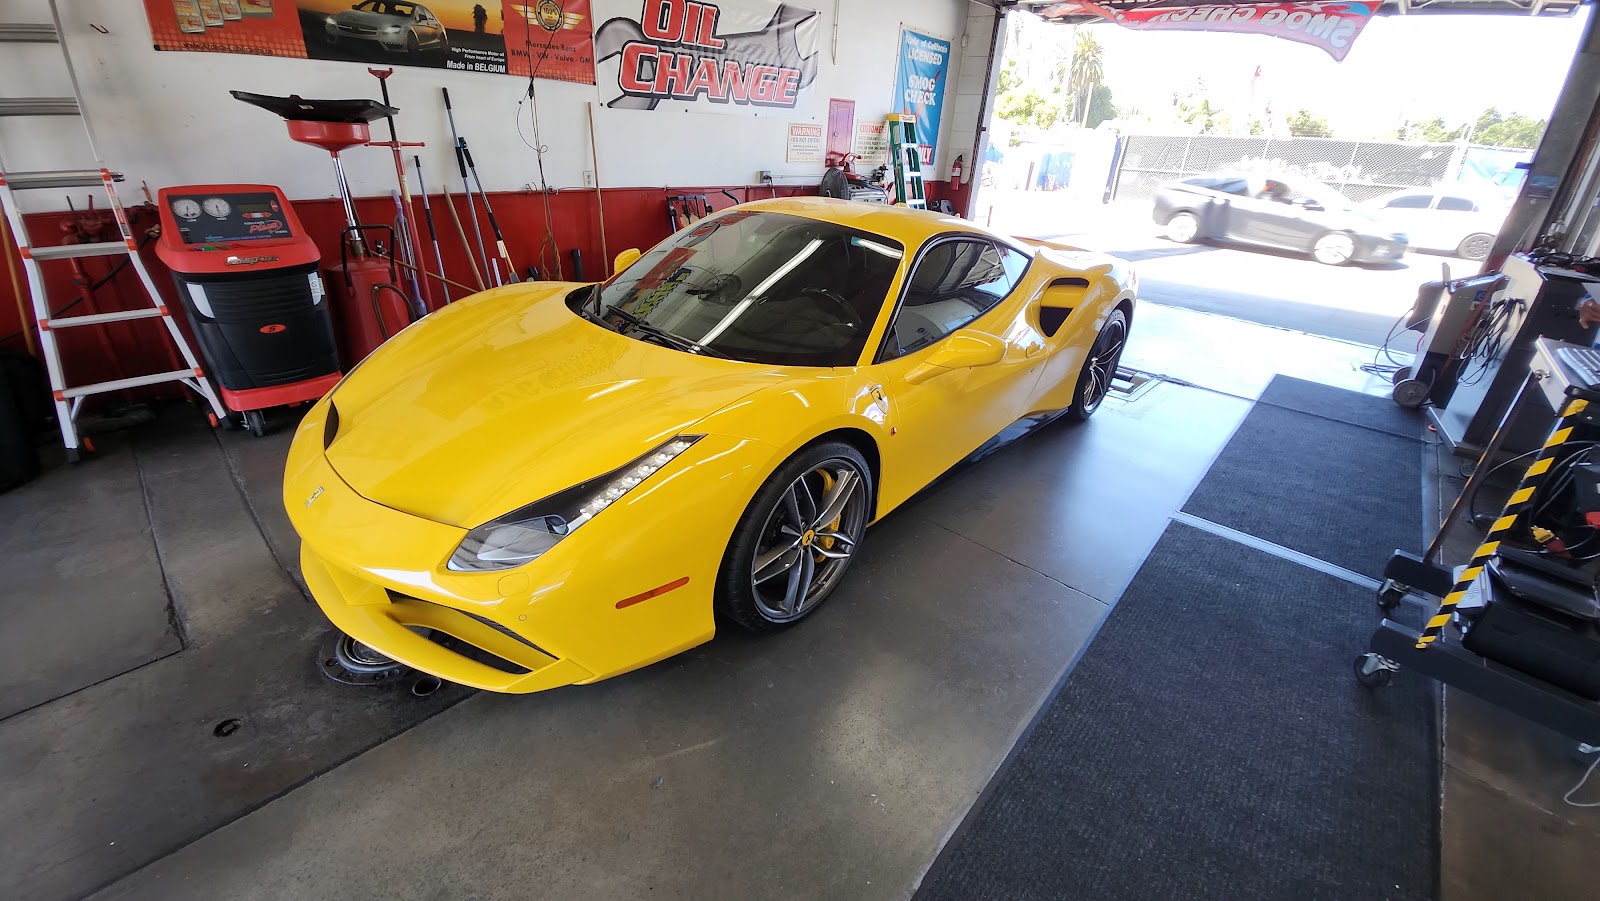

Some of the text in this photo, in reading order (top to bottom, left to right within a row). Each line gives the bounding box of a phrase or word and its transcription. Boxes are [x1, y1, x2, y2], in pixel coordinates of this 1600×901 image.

[641, 0, 727, 49] OIL
[462, 47, 487, 56] Performance
[904, 34, 948, 54] State of California
[554, 54, 574, 63] Volvo
[908, 48, 942, 65] LICENSED
[447, 60, 506, 74] Made in BELGIUM
[619, 42, 800, 104] CHANGE
[908, 74, 936, 91] SMOG
[904, 88, 937, 106] CHECK
[792, 126, 821, 136] WARNING
